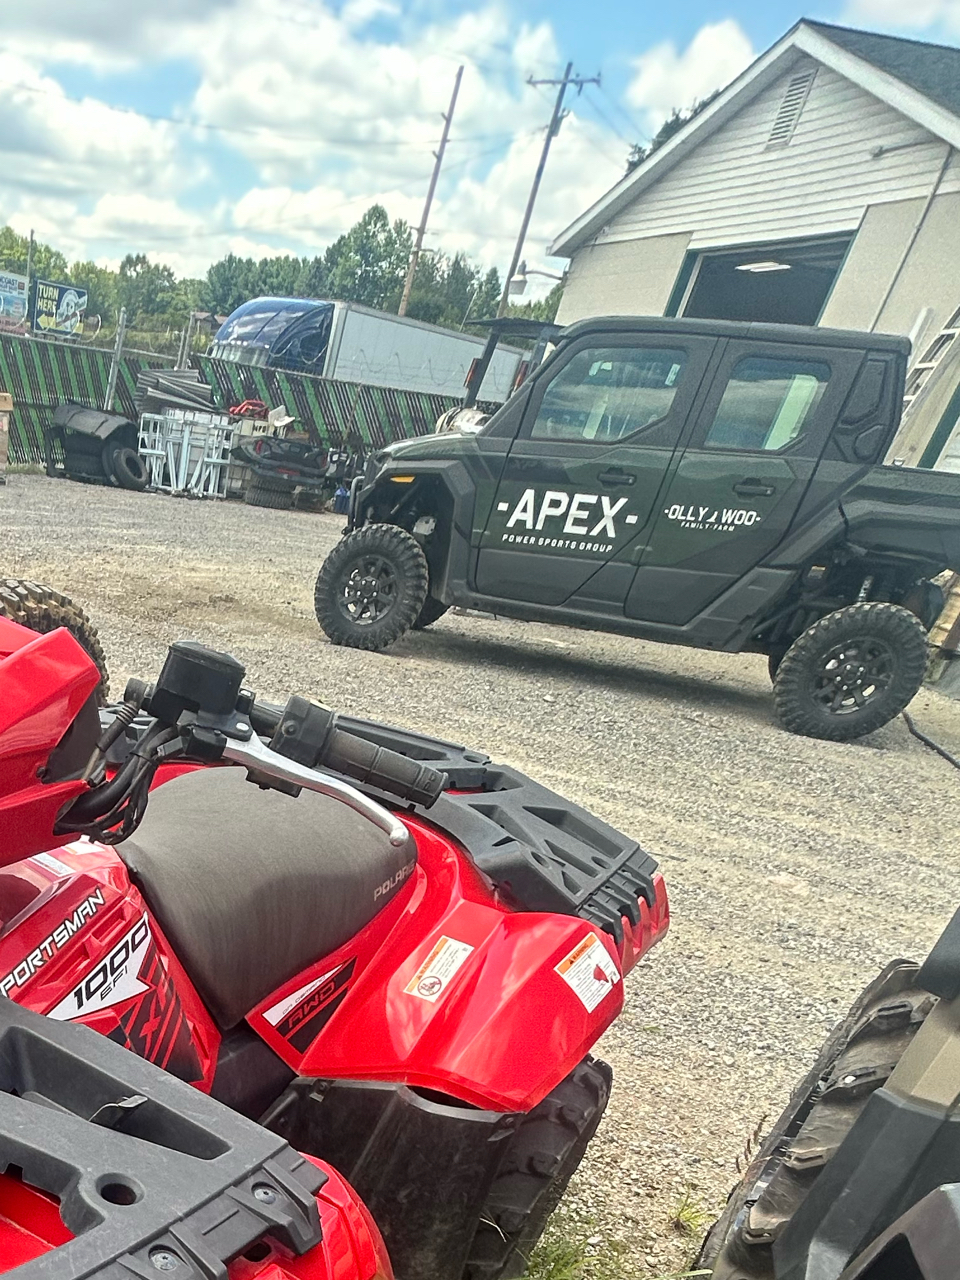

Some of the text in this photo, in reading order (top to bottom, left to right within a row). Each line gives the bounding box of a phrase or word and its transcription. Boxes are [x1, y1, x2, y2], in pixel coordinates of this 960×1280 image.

[37, 298, 58, 312] HERE
[38, 284, 60, 300] TURN
[505, 488, 629, 538] APEX
[502, 533, 613, 553] POWER SPORTS GROUP
[73, 919, 149, 1010] 1000
[100, 966, 129, 1001] EFI
[288, 981, 336, 1029] AWD
